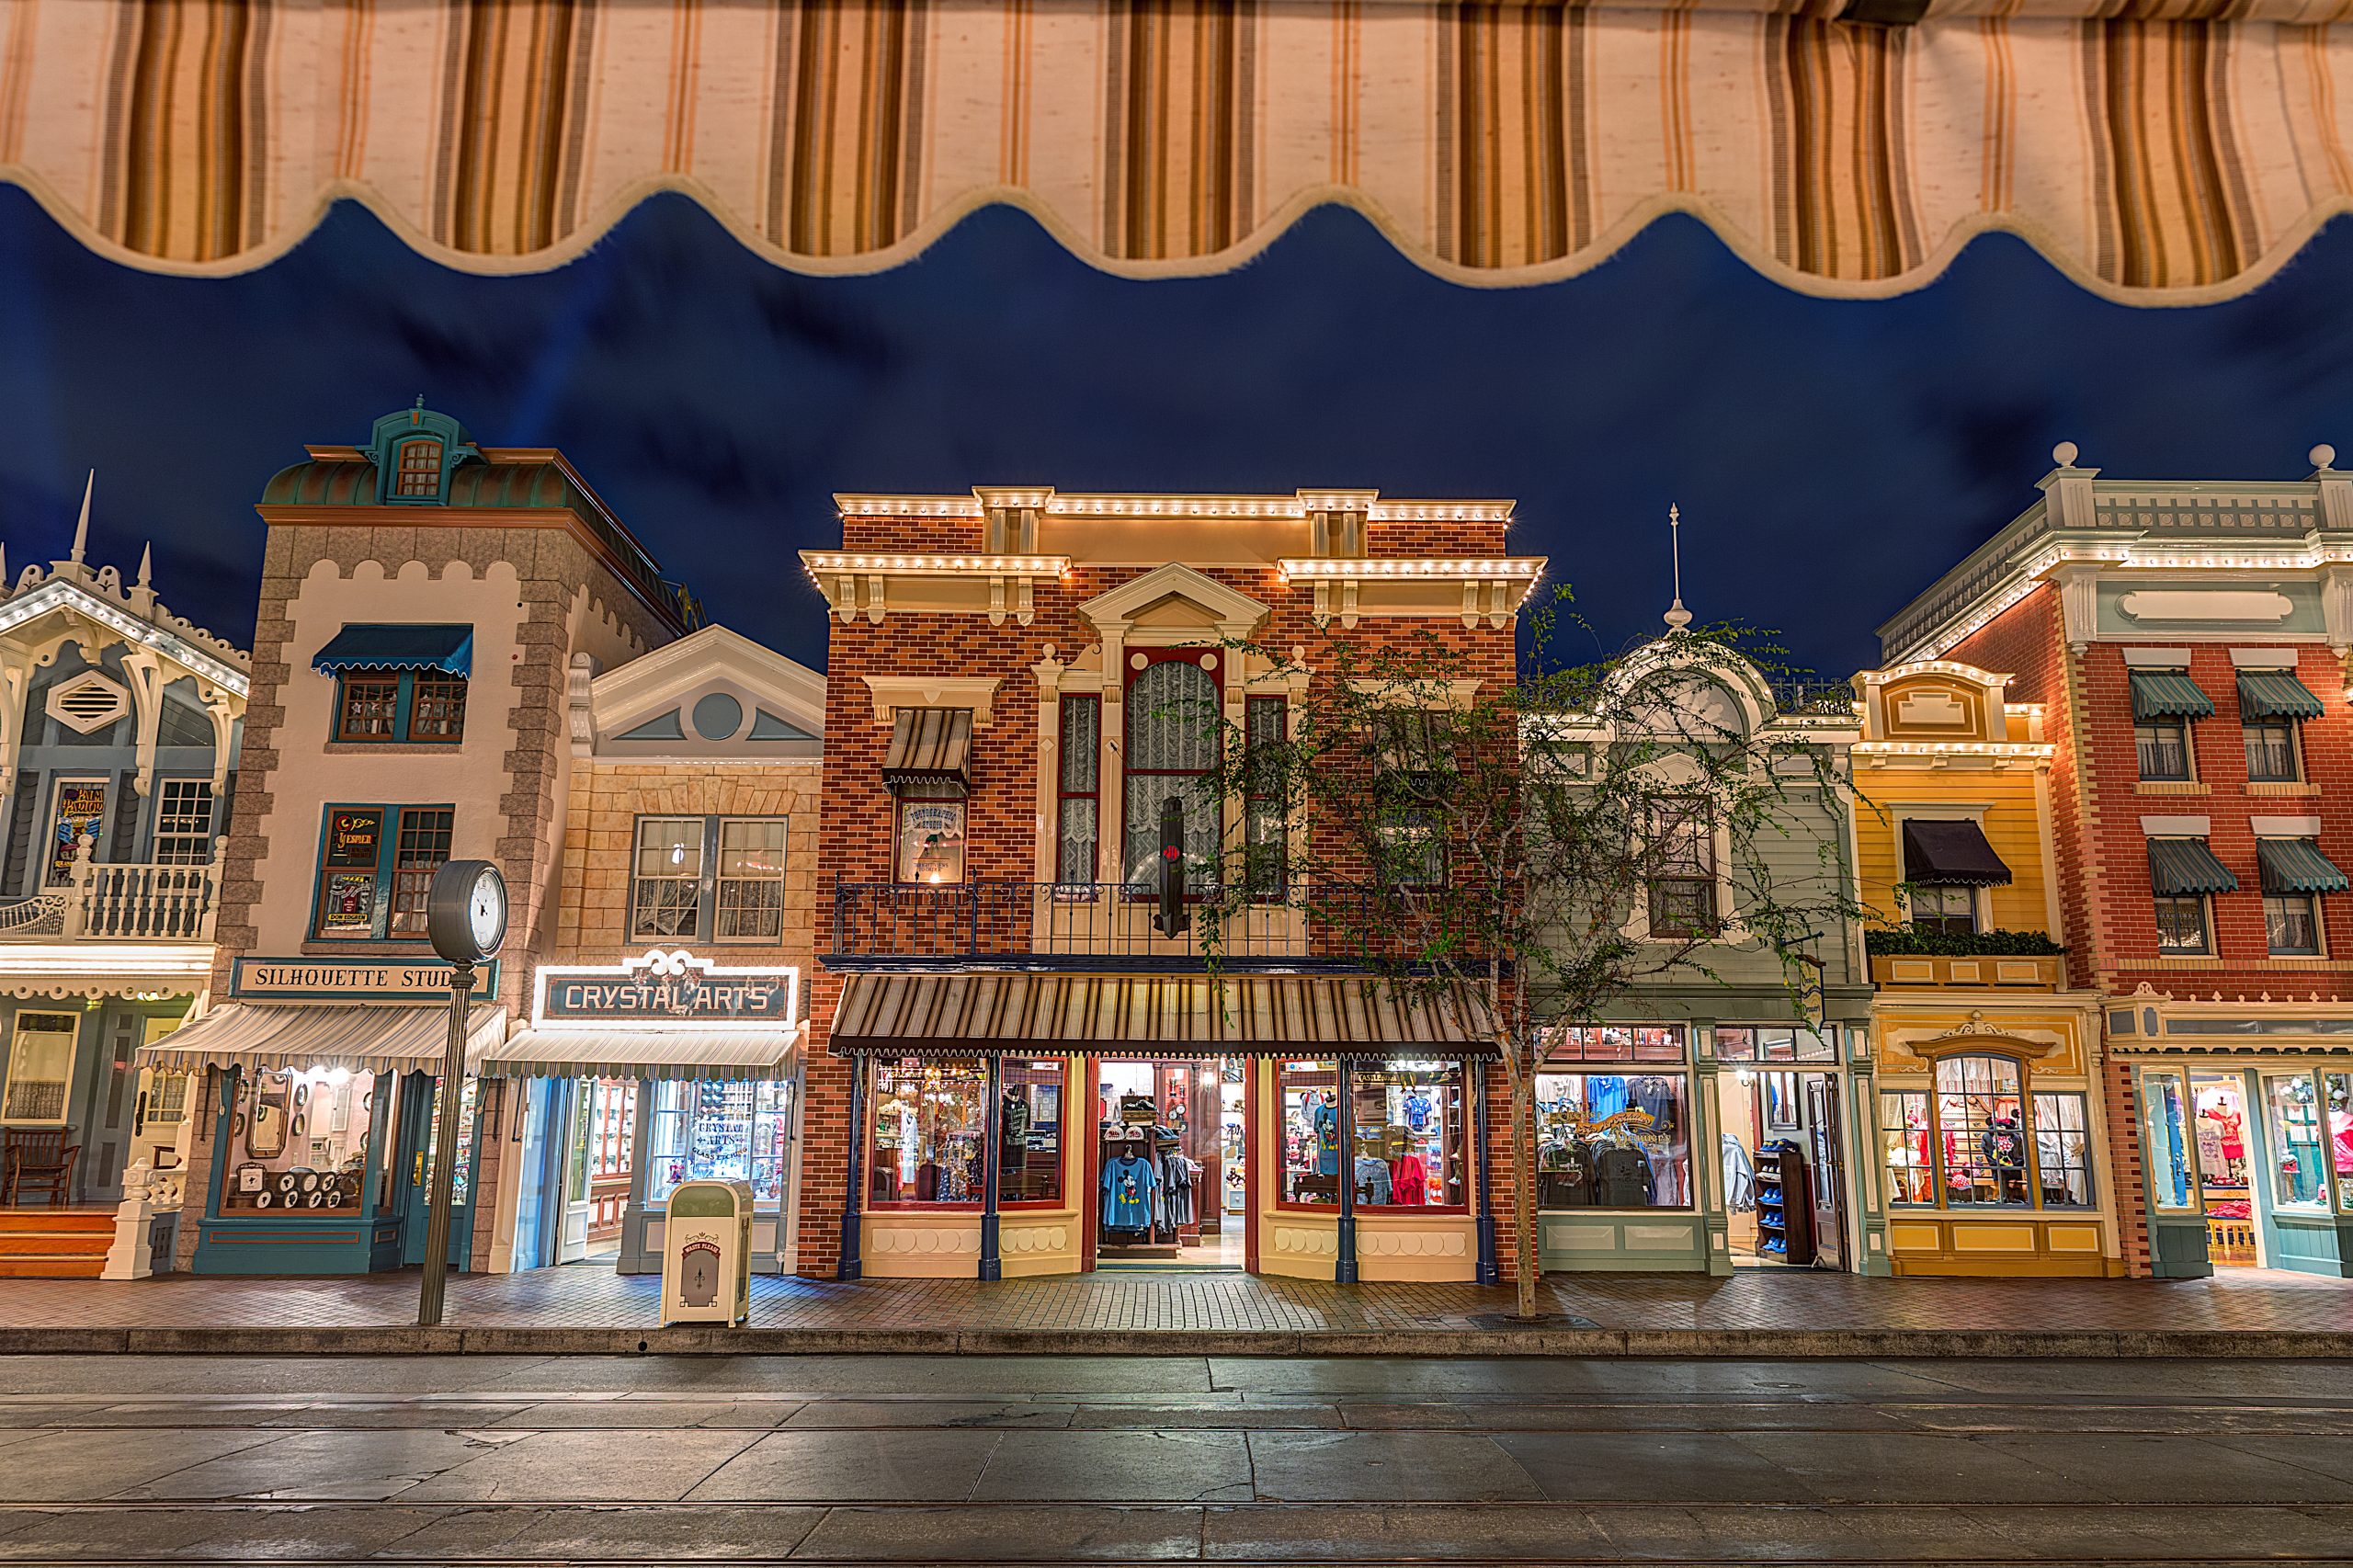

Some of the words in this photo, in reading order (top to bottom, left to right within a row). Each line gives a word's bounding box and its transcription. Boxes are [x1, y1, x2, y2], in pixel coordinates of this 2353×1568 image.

[77, 789, 103, 801] PALM
[62, 799, 104, 815] PARLOR
[910, 809, 957, 822] PHOTOGRAPHIC
[922, 821, 942, 829] STUDIO
[255, 968, 388, 987] SILHOUETTE
[401, 970, 452, 988] STUD
[565, 985, 686, 1010] CRYSTAL
[695, 986, 769, 1010] ARTS
[699, 1122, 744, 1132] CRYSTAL
[707, 1135, 735, 1145] ARTS
[692, 1147, 715, 1160] GLASS
[716, 1147, 747, 1160] ETCHING
[684, 1244, 700, 1253] WASTE
[701, 1244, 719, 1254] PLEASE
